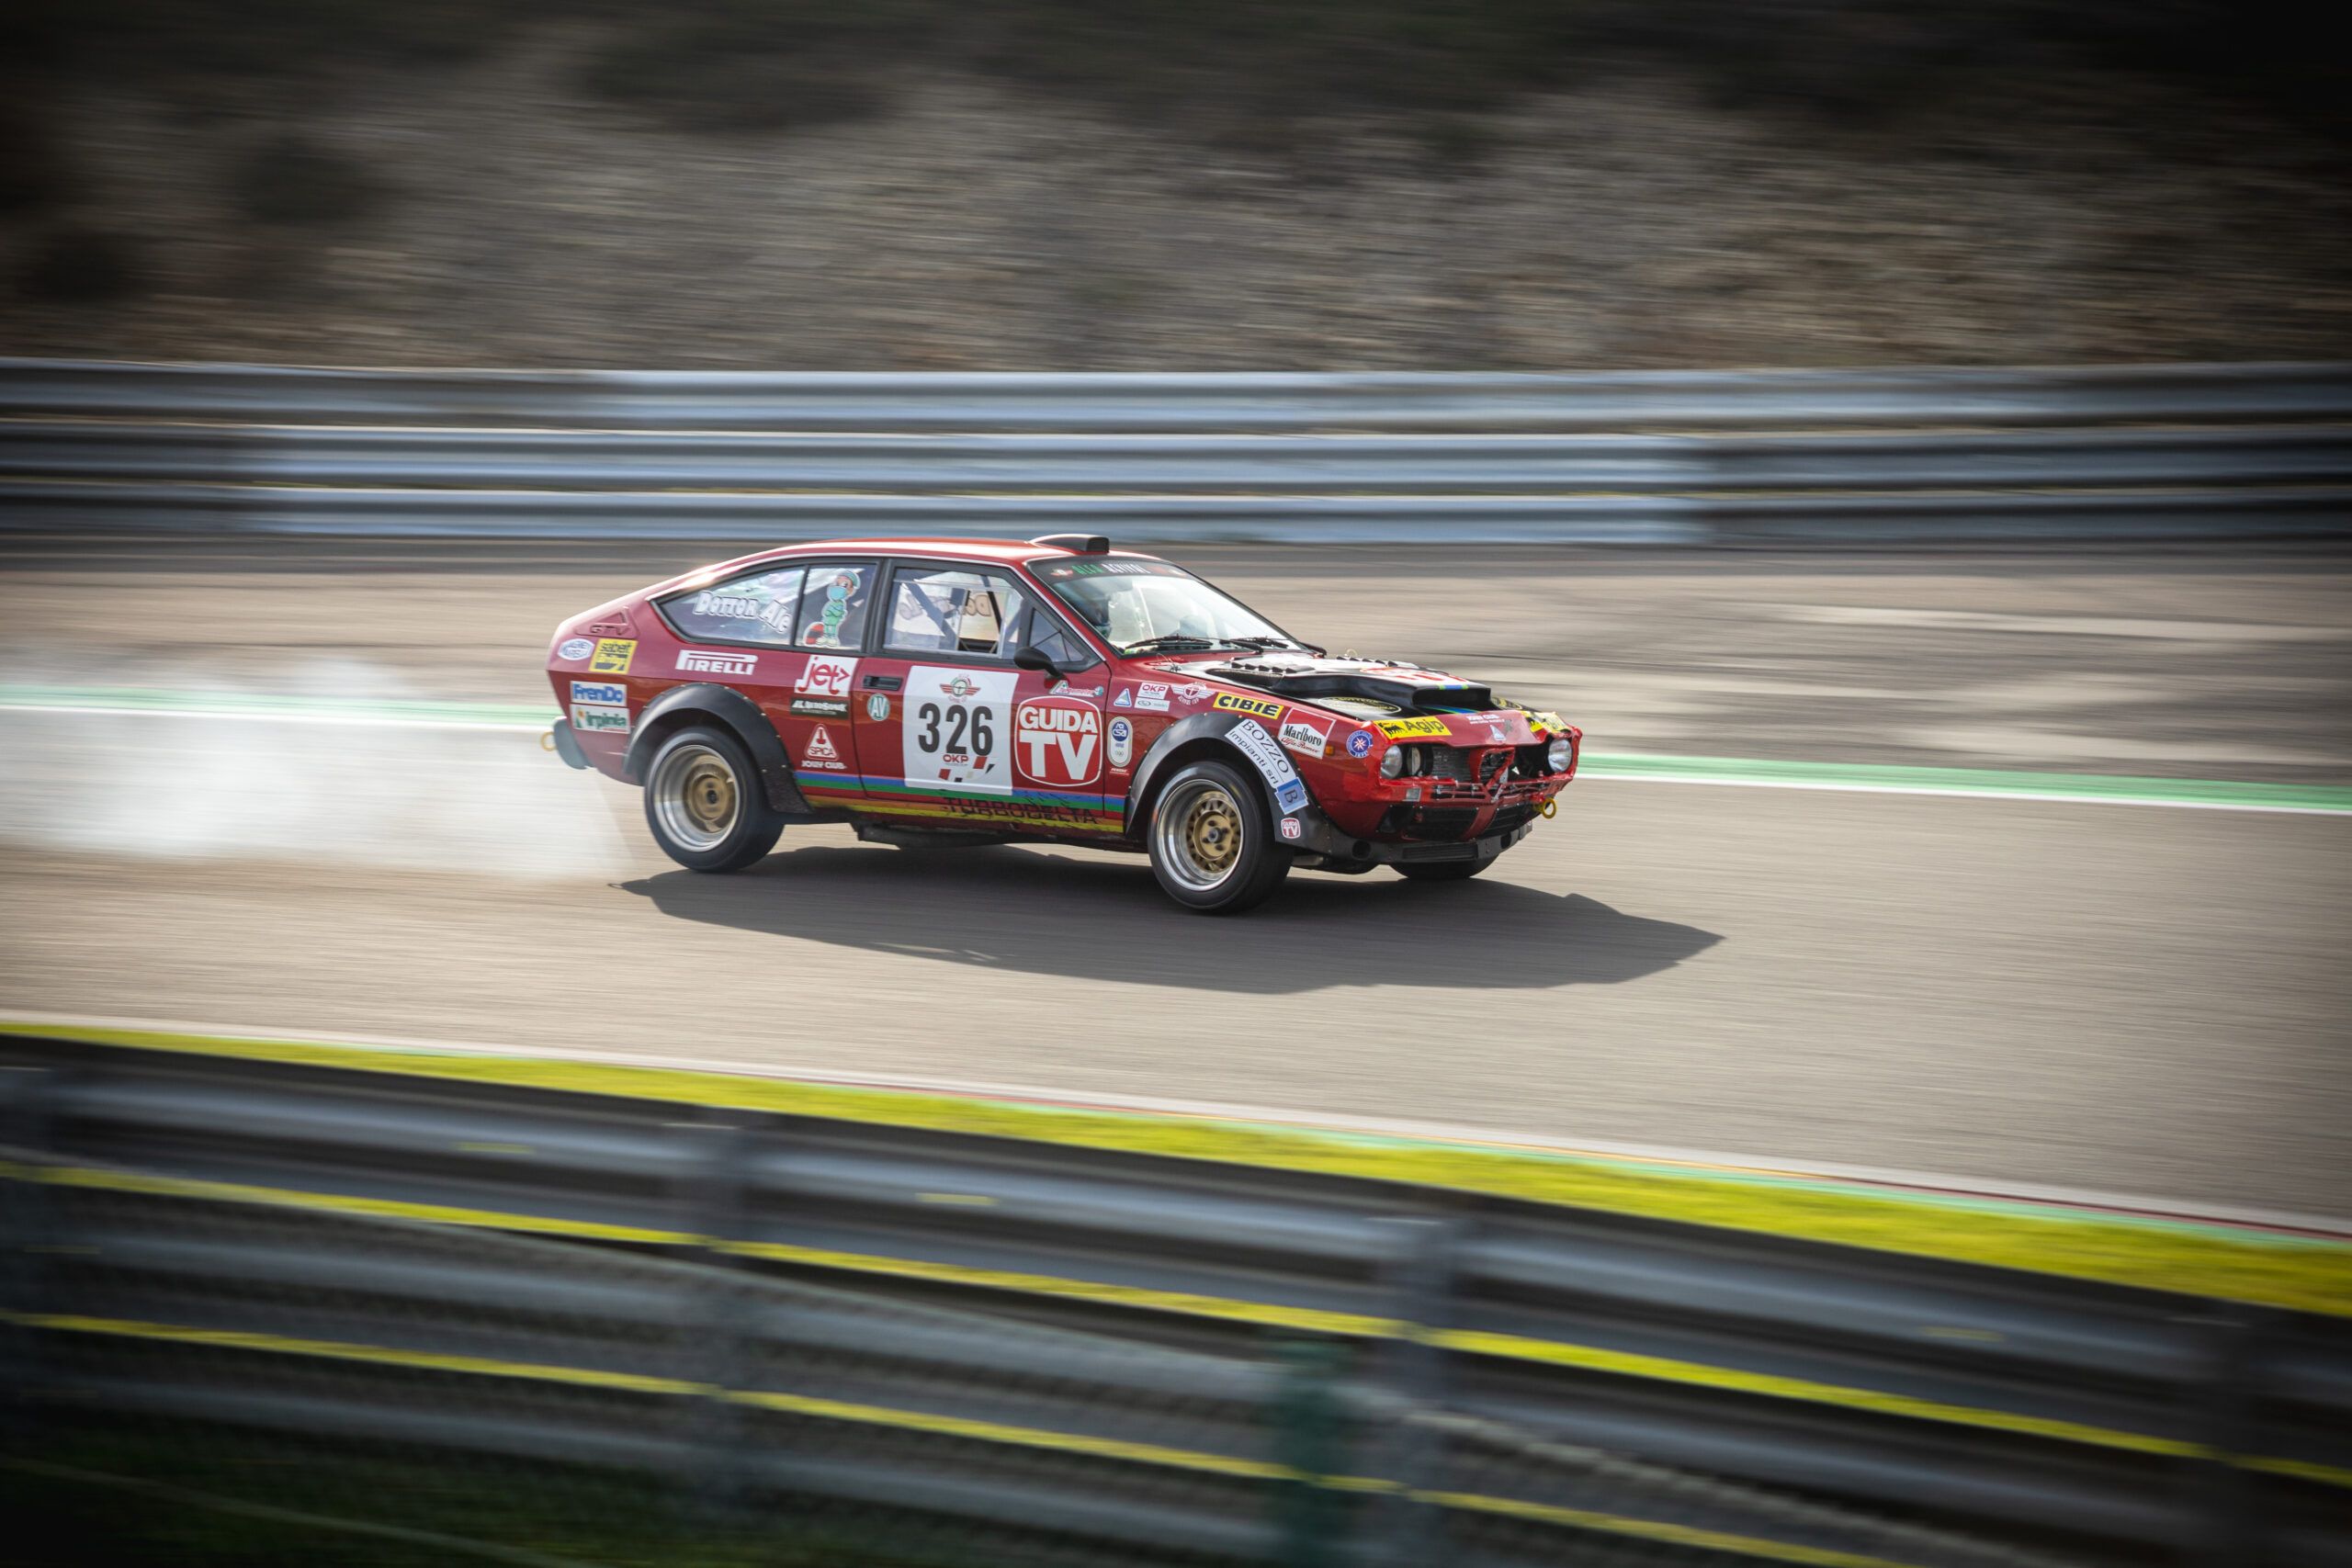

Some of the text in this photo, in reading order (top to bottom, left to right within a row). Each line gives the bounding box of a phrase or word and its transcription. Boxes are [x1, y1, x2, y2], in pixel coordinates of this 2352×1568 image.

[589, 625, 630, 636] GTV
[675, 649, 758, 675] PIRELLI
[1142, 684, 1166, 693] OKP
[1218, 695, 1280, 716] CIBIE
[1019, 706, 1098, 733] GUIDA
[1404, 718, 1444, 734] Agip
[918, 703, 993, 756] 326
[1283, 724, 1322, 746] Marlboro
[1019, 729, 1098, 780] TV
[1242, 720, 1289, 773] BOZZO
[943, 754, 969, 763] OKP
[1266, 768, 1279, 784] srl
[1283, 789, 1298, 804] B
[1283, 826, 1297, 837] TV
